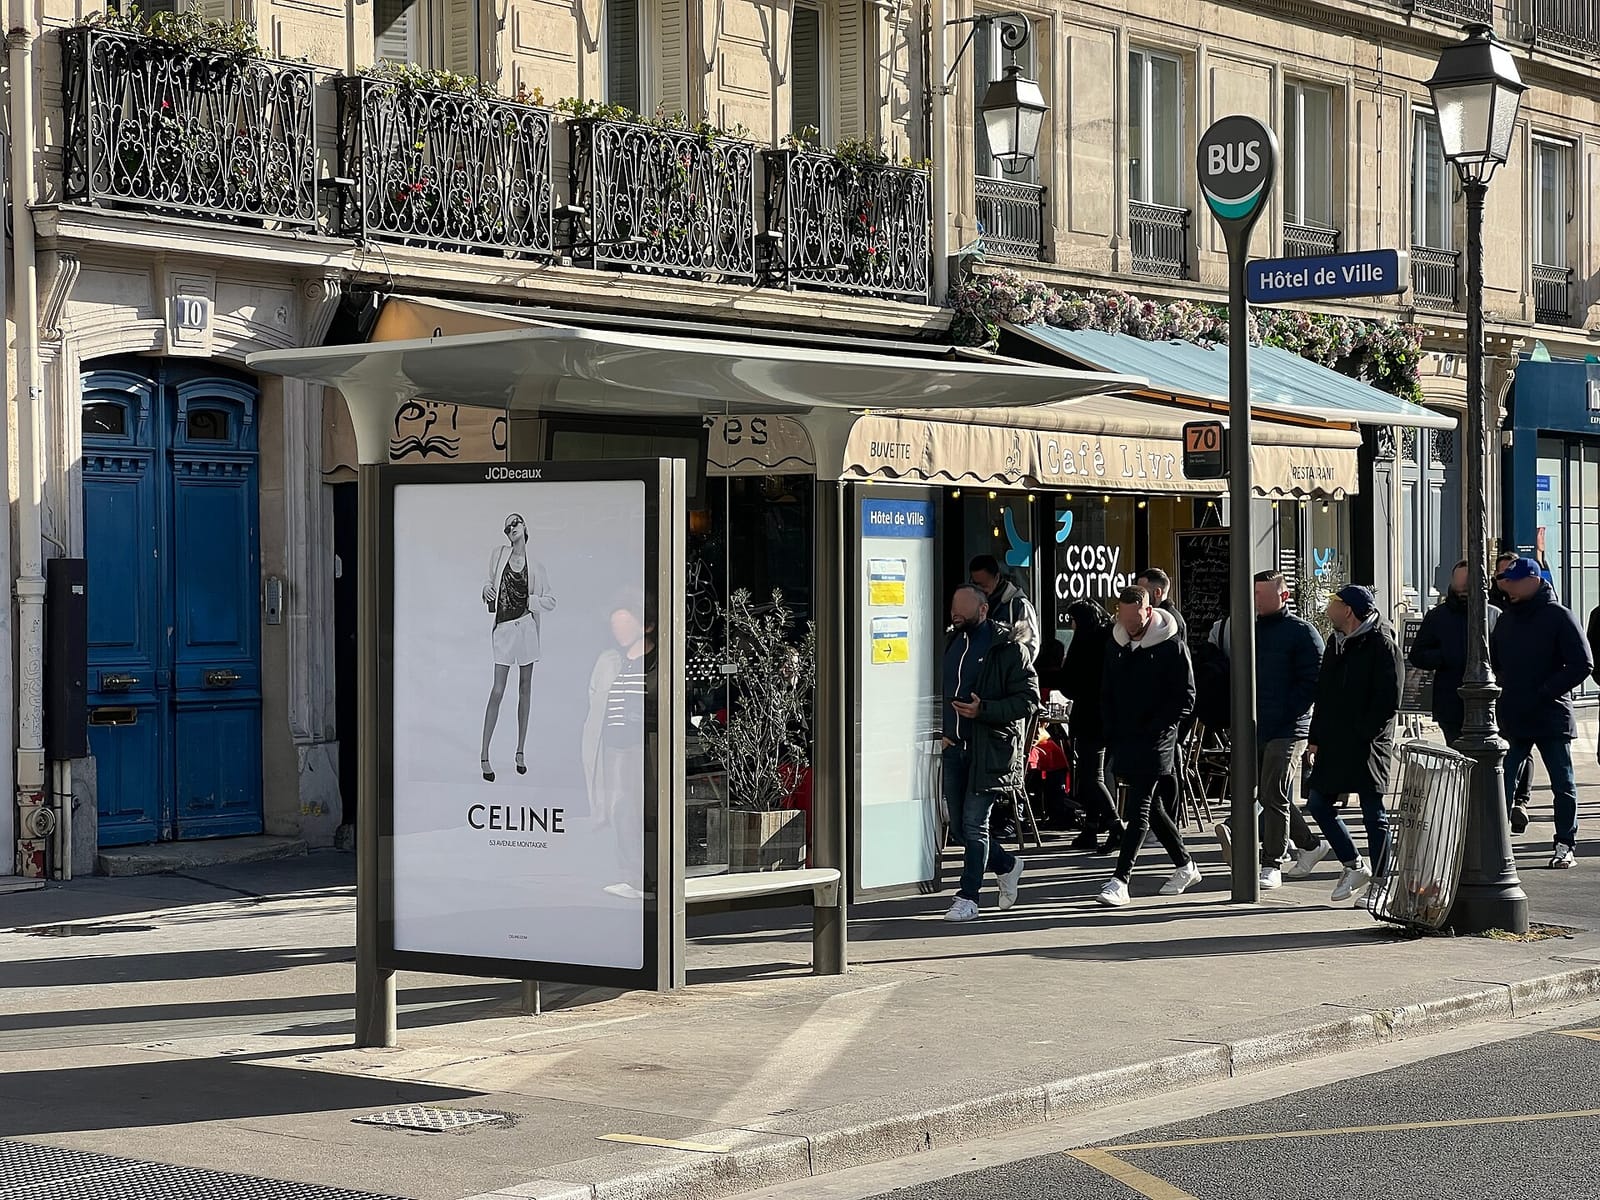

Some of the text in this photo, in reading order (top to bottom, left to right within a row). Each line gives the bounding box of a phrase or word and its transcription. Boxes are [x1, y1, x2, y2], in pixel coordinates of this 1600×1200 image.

[1208, 140, 1261, 175] BUS
[1260, 264, 1383, 289] Hôtel de Ville
[183, 299, 202, 326] 10
[870, 441, 911, 459] BUVETTE
[1191, 429, 1216, 449] 70
[1047, 439, 1185, 480] Café Livr
[484, 467, 542, 480] JCDecaux
[1292, 466, 1335, 480] RESTARANT
[870, 511, 924, 526] Hôtel de Ville
[1067, 545, 1119, 580] cosy
[1055, 572, 1136, 599] corner
[467, 804, 565, 833] CELINE
[489, 839, 495, 847] 53
[517, 841, 547, 849] MONTAIGNE
